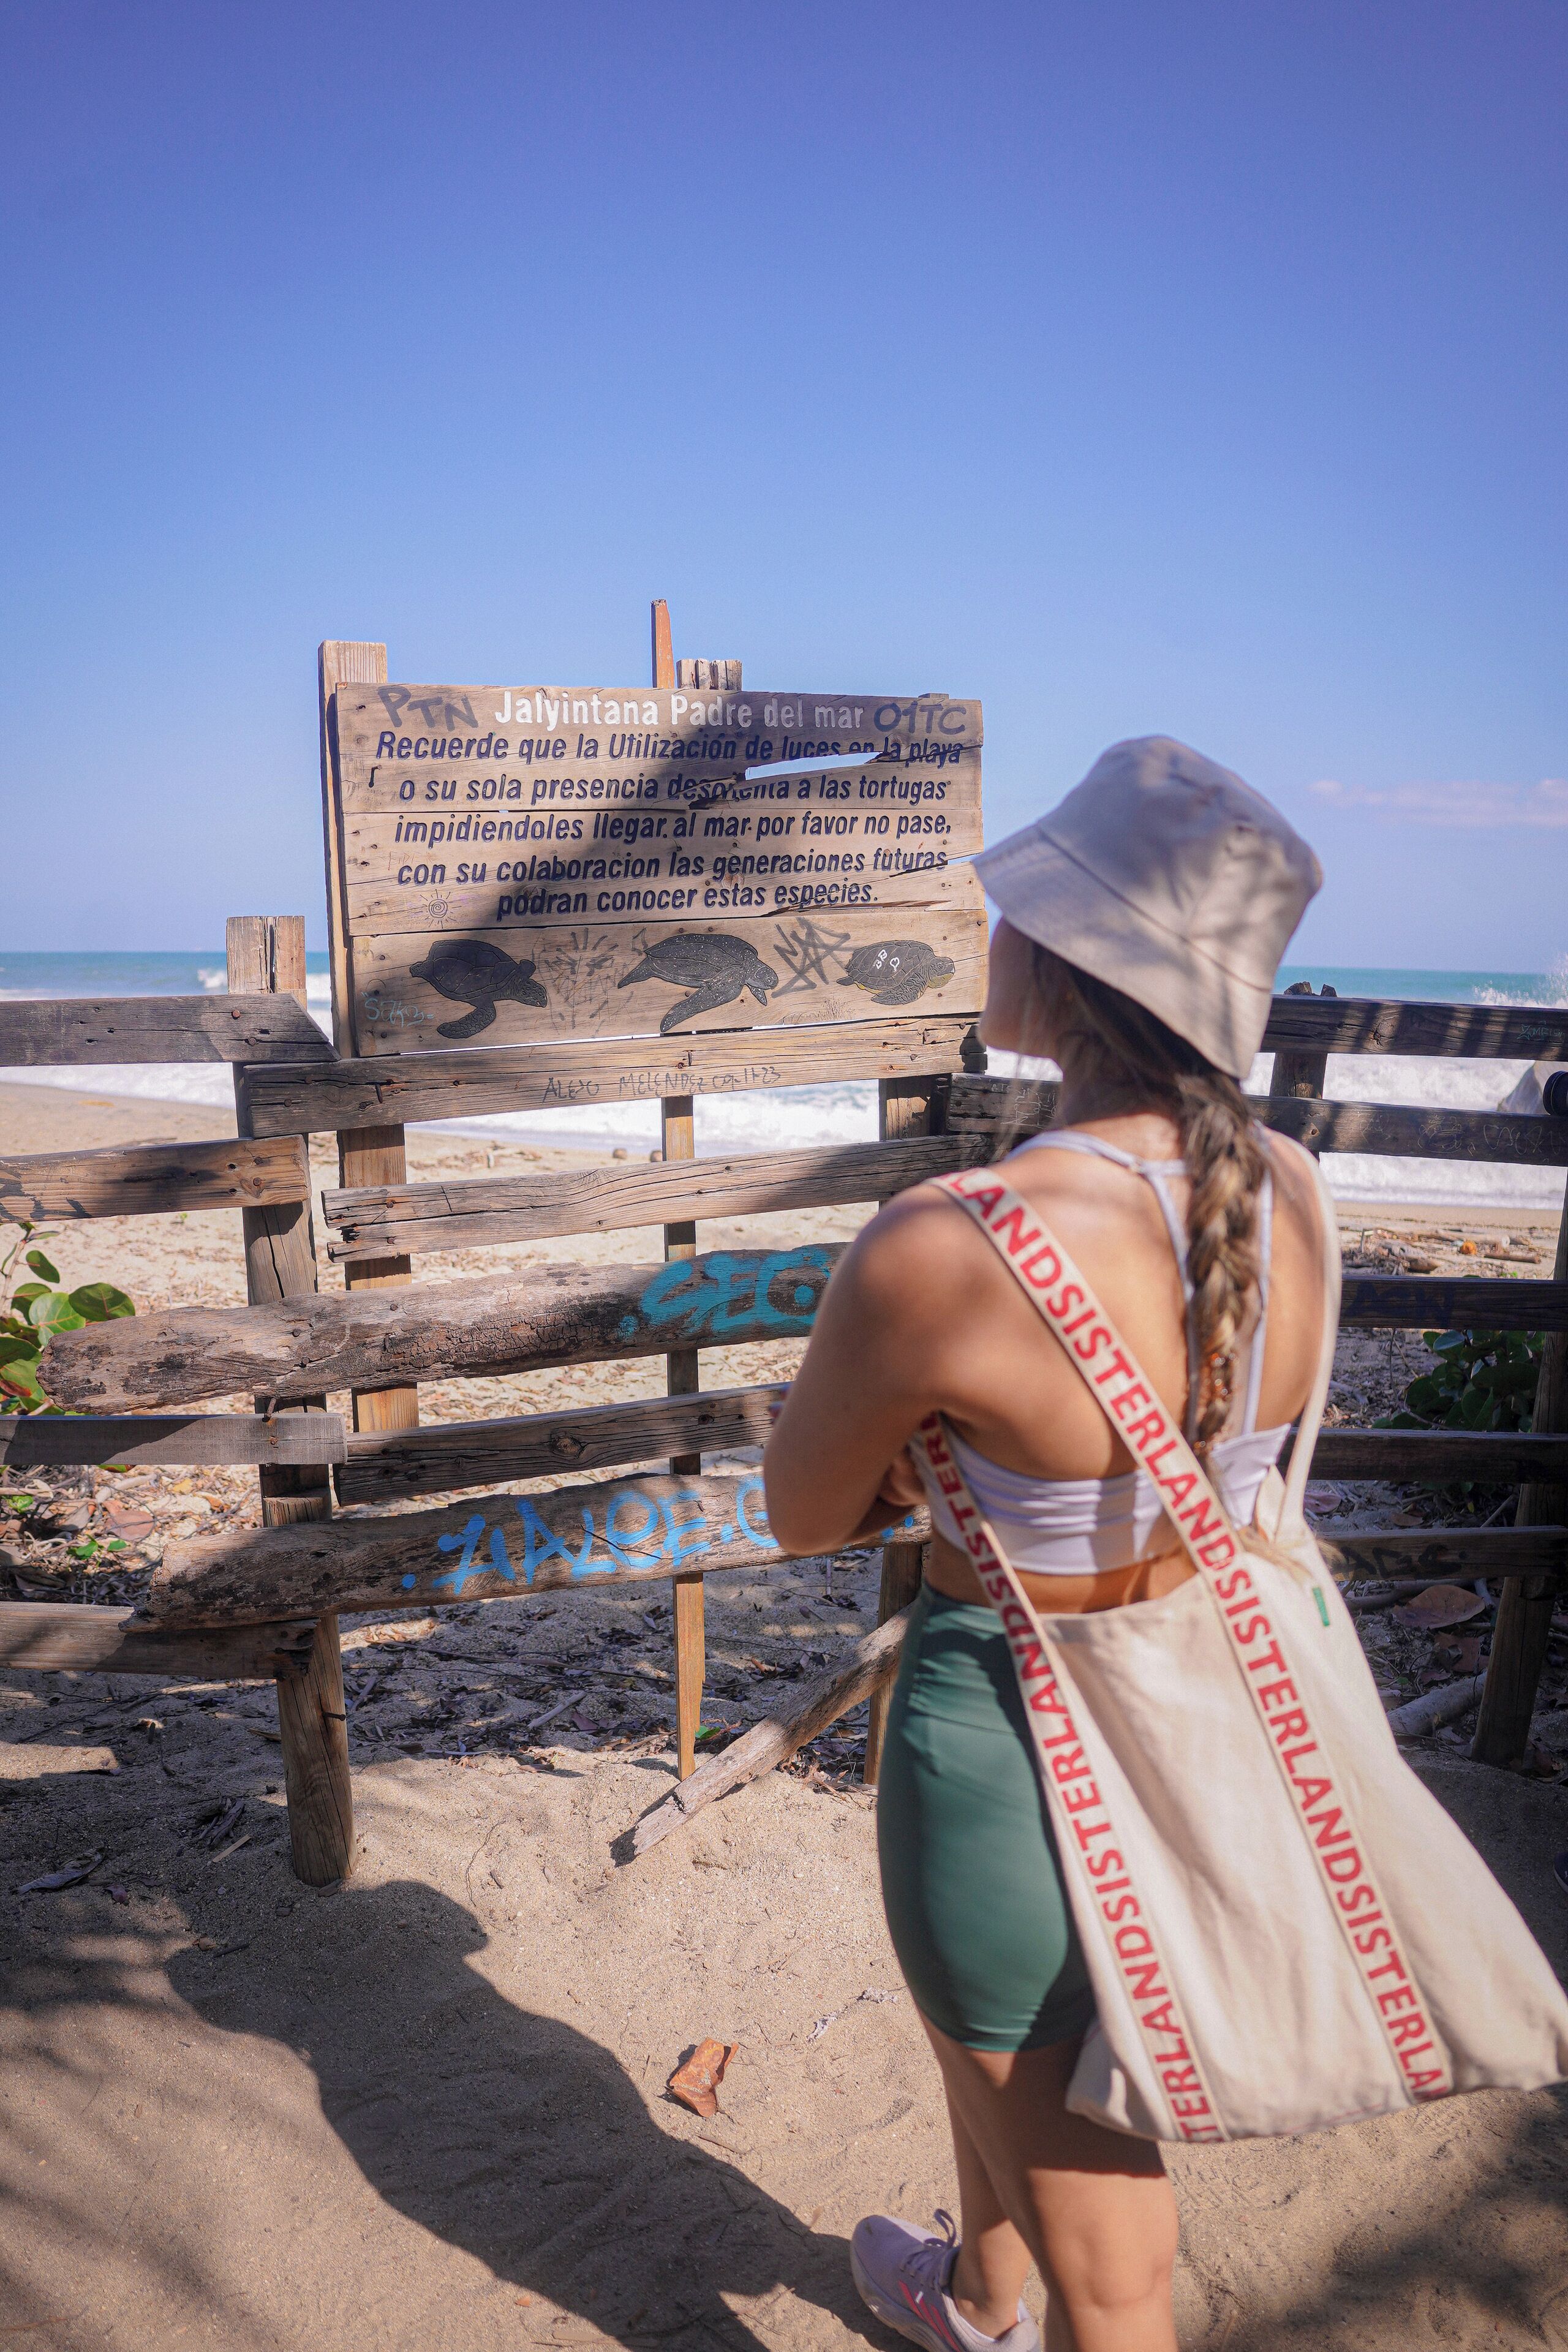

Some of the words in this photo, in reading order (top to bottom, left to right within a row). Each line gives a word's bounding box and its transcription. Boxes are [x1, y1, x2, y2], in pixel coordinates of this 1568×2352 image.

[377, 685, 479, 731] PTN
[495, 691, 659, 731] Jalyintana
[671, 695, 752, 728] Padre
[764, 698, 804, 728] del
[815, 705, 865, 729] mar
[376, 731, 509, 760] Recuerde
[519, 739, 567, 764] que
[576, 734, 598, 759] la
[609, 733, 737, 760] Utilización
[745, 735, 773, 760] de
[782, 736, 841, 760] luces
[849, 741, 875, 753] en
[883, 737, 902, 763] la
[905, 738, 965, 769] playa
[399, 780, 415, 802] o
[426, 780, 457, 802] su
[466, 774, 522, 802] sola
[531, 773, 659, 805] presencia
[797, 780, 812, 800] a
[819, 775, 851, 800] las
[859, 775, 947, 806] tortugas
[394, 815, 584, 849] impidiendoles
[673, 812, 697, 839] al
[756, 816, 796, 842] por
[801, 810, 858, 836] favor
[864, 815, 890, 835] no
[895, 815, 951, 840] pase,
[398, 864, 447, 886] con
[456, 863, 487, 885] su
[496, 852, 661, 883] colaboracion
[669, 851, 704, 878] las
[712, 848, 865, 883] generaciones
[873, 848, 948, 872] futuras
[496, 888, 588, 922] podran
[597, 886, 697, 912] conocer
[704, 883, 766, 908] estas
[775, 877, 878, 910] especies.
